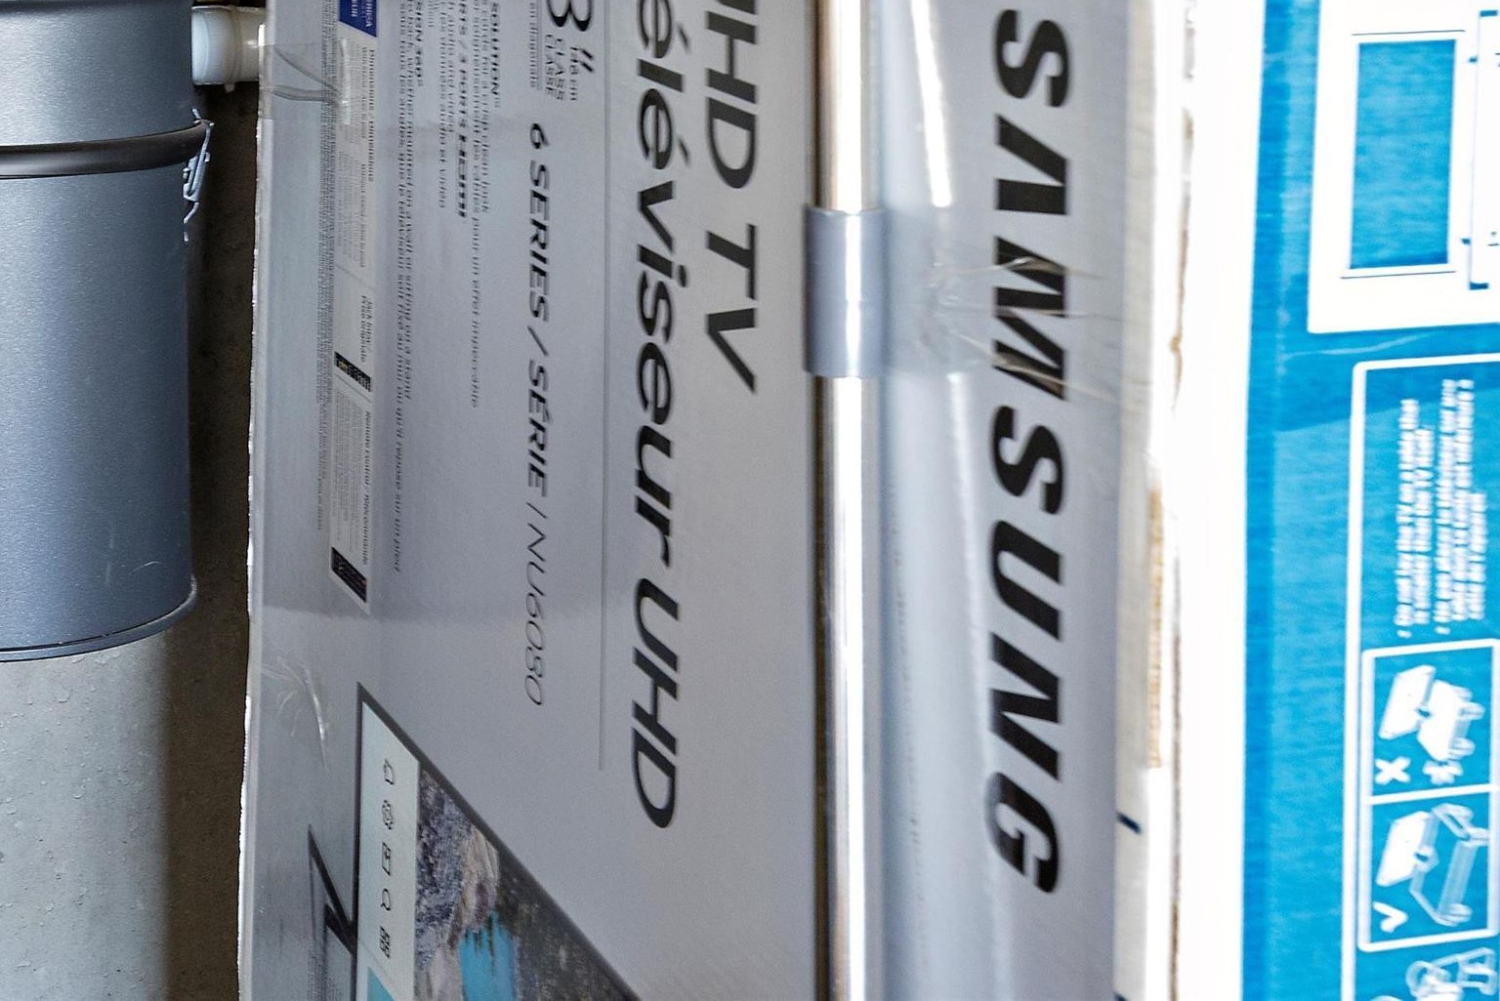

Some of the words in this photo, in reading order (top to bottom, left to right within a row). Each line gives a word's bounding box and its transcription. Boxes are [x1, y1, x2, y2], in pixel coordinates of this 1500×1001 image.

[530, 122, 549, 148] 6
[528, 160, 550, 320] SERIES
[706, 223, 759, 394] TV
[528, 359, 551, 497] SÉRIE
[984, 8, 1074, 894] SAMSUNG
[632, 578, 681, 829] UHD
